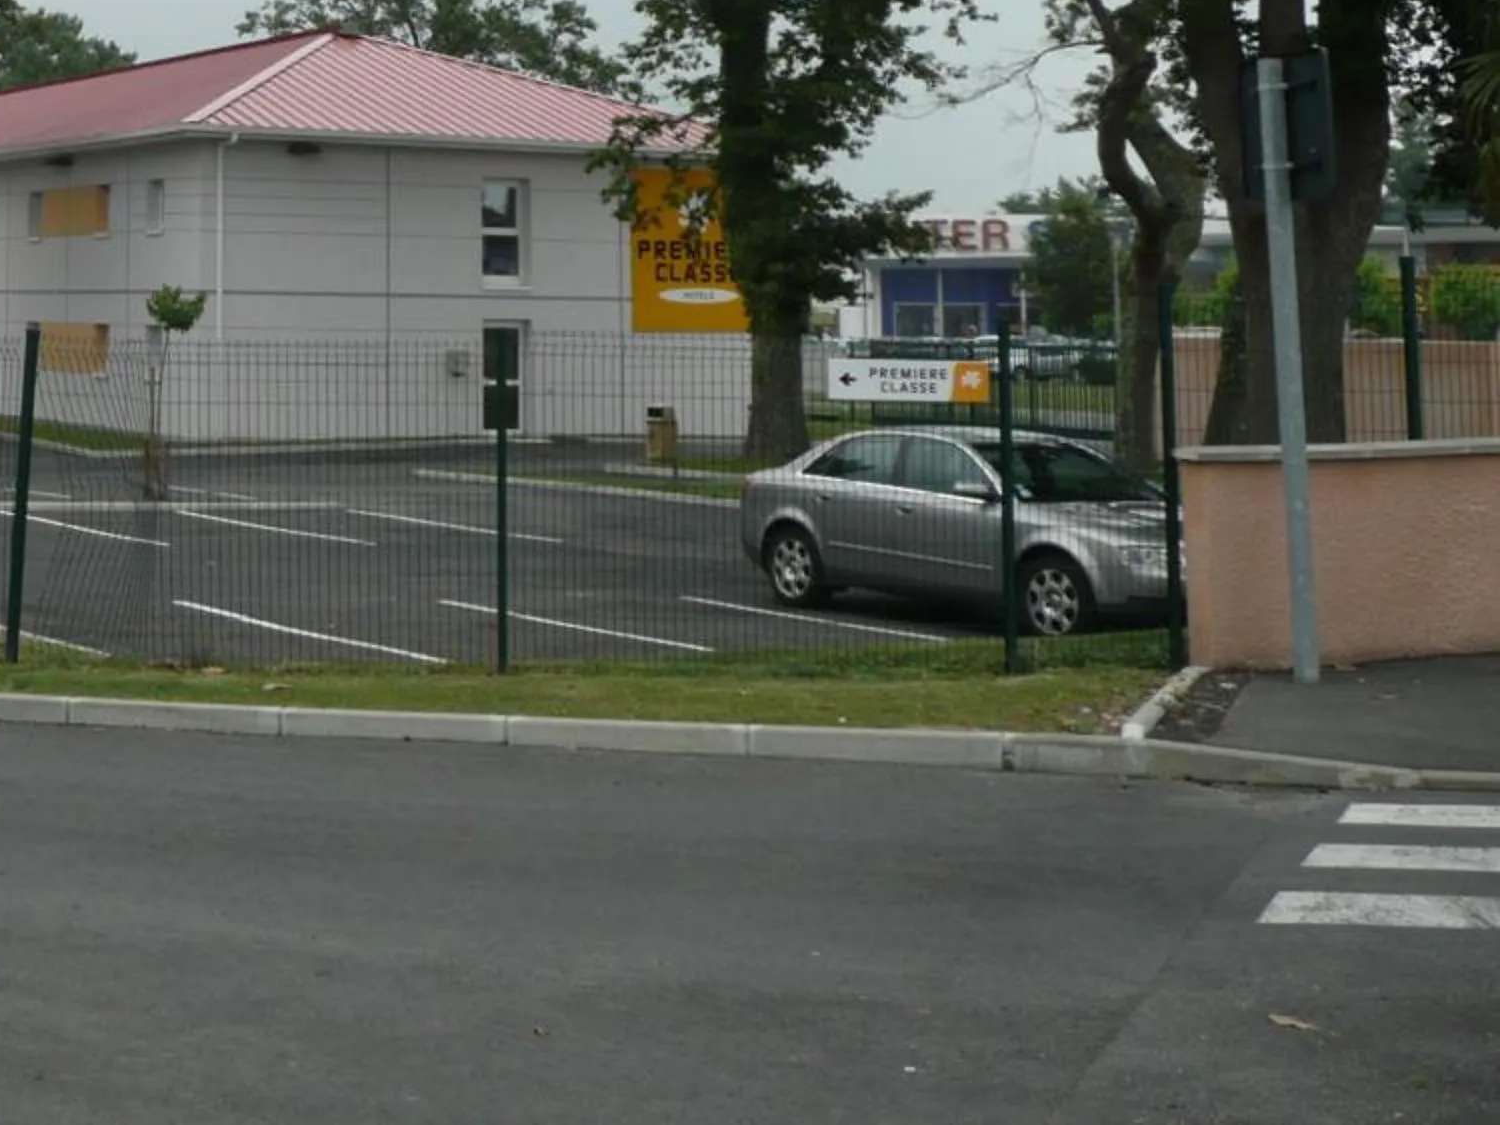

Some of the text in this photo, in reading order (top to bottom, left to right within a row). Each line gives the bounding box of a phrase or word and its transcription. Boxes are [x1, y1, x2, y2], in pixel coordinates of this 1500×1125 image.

[922, 218, 1011, 252] TER
[637, 239, 726, 260] PREMIE
[655, 262, 733, 283] CLASS
[868, 367, 949, 380] PREMIERE
[880, 381, 938, 394] CLASSE
